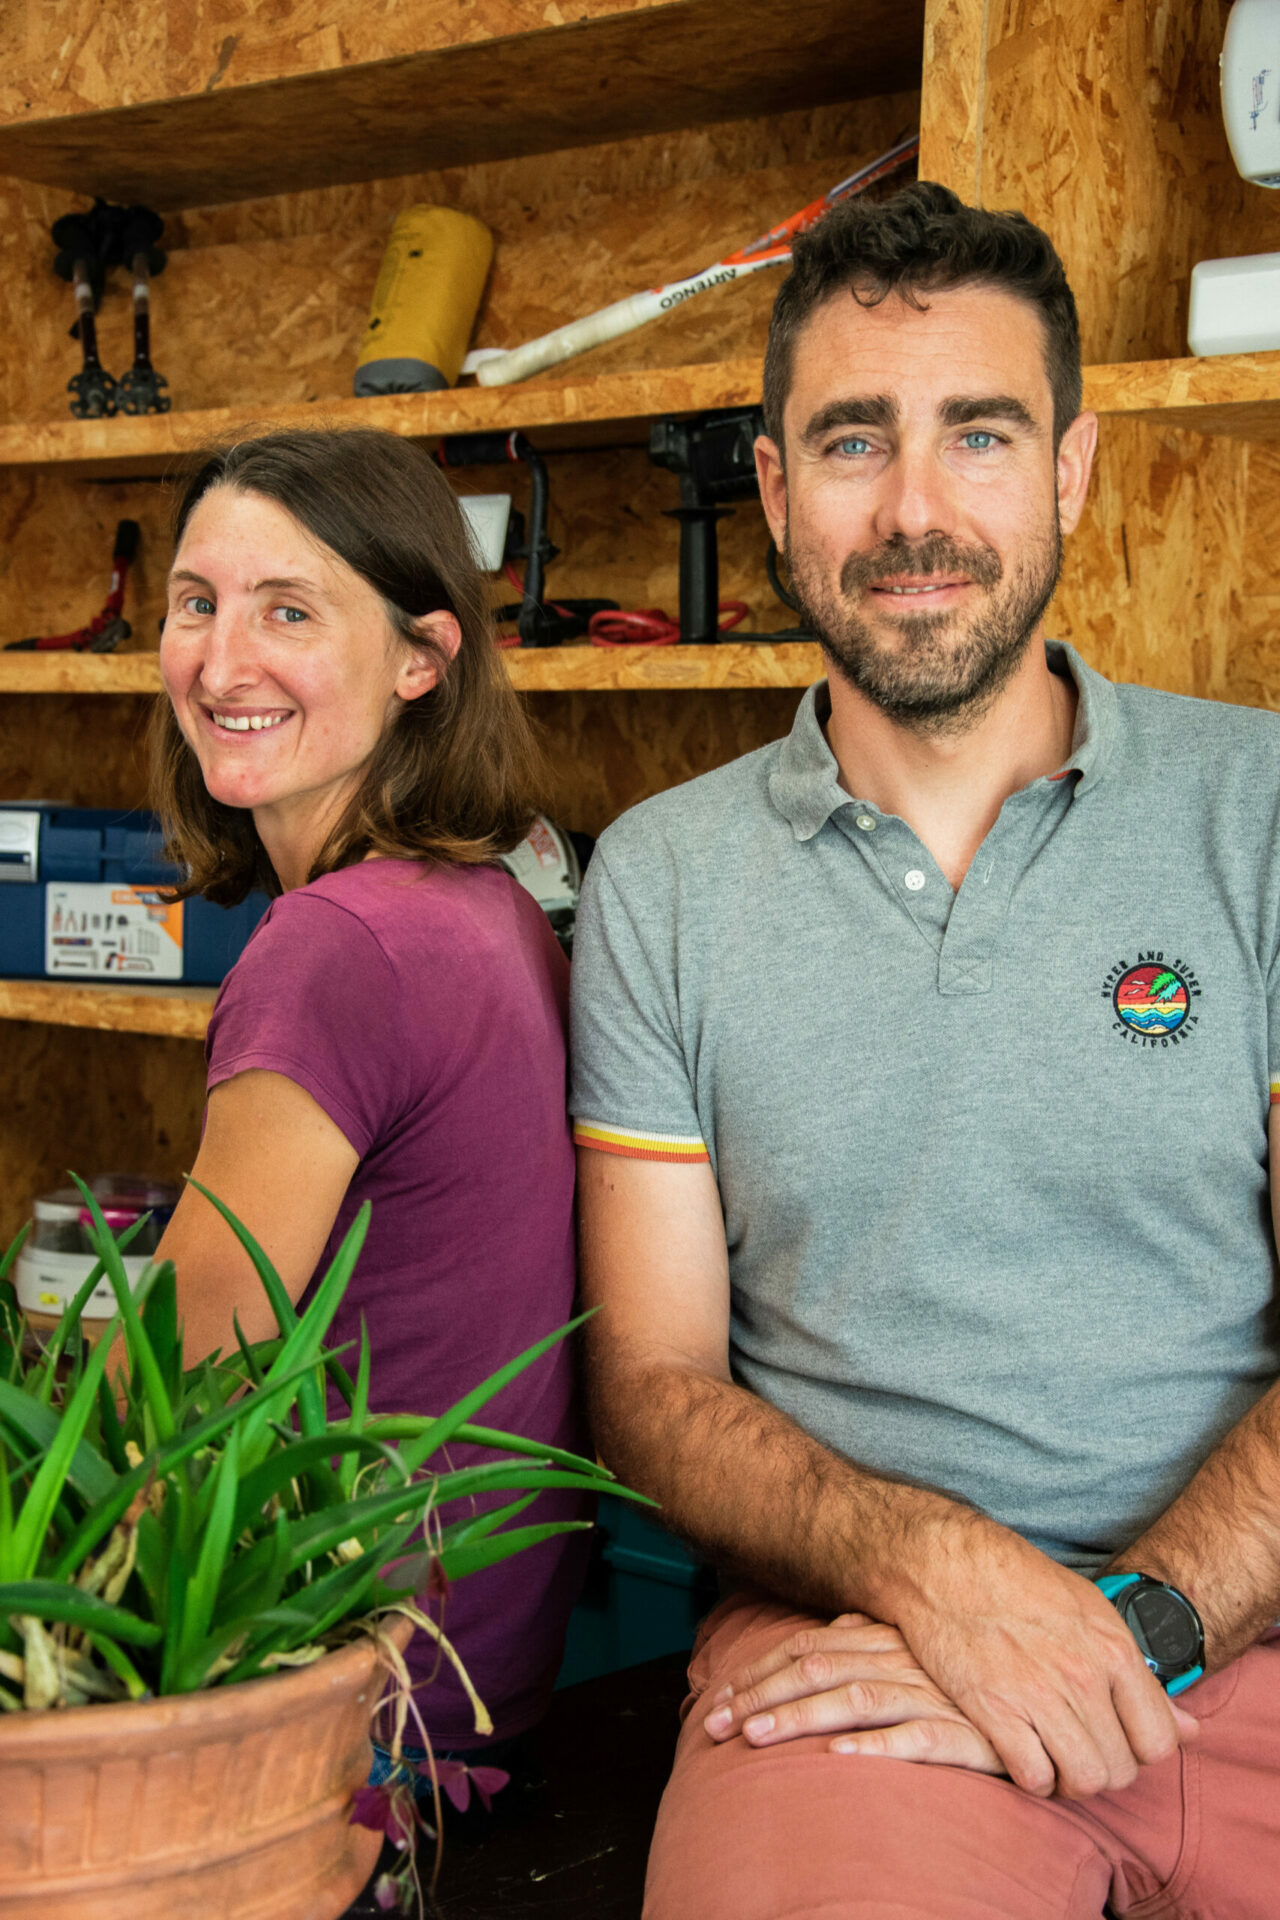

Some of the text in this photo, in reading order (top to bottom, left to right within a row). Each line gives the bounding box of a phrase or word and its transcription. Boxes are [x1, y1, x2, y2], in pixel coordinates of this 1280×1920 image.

[660, 268, 737, 310] ARTENGO
[1101, 951, 1202, 998] HYPER AND SUPER
[1112, 1016, 1199, 1048] CALIFORNIA
